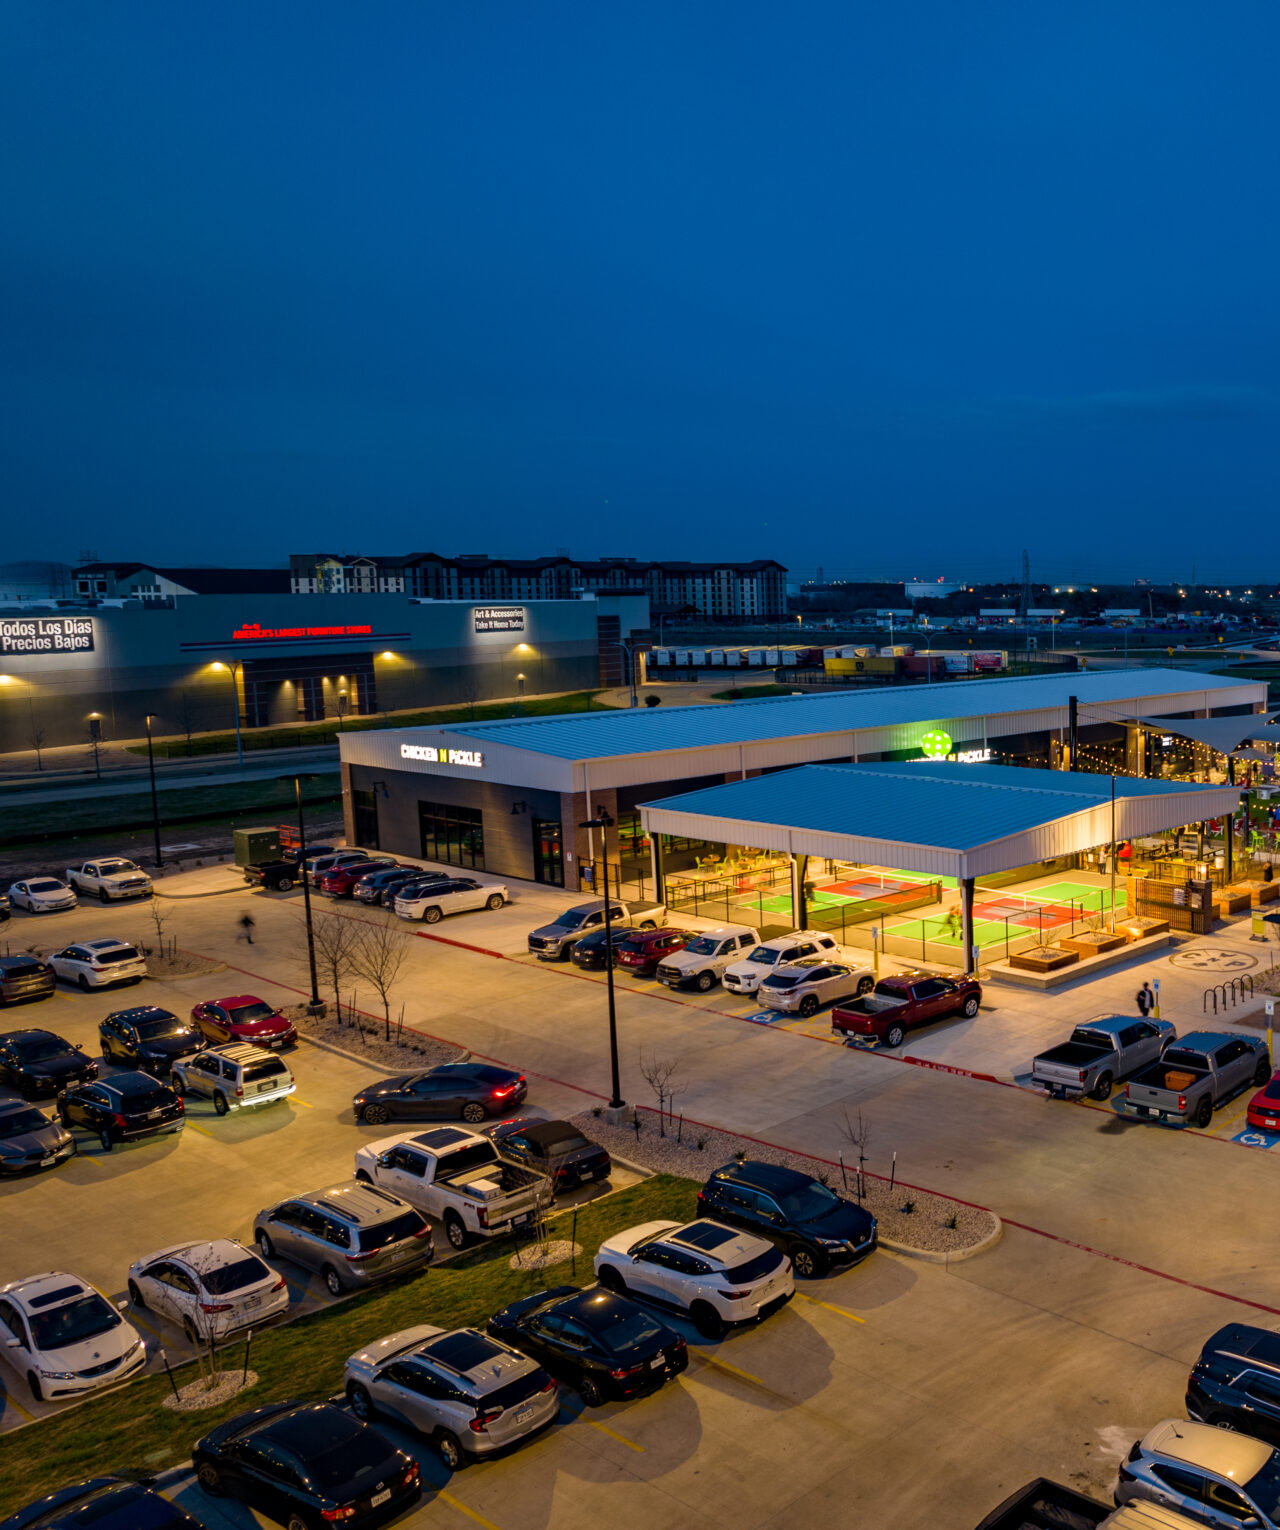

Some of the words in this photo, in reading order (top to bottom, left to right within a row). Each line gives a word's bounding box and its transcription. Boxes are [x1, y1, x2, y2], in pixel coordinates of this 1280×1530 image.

[476, 610, 484, 618] Art
[491, 609, 523, 618] Accessories
[38, 620, 61, 635] Los
[476, 621, 488, 629] Take
[494, 620, 508, 628] Home
[2, 635, 52, 650] Precios
[54, 634, 90, 651] Bajos
[400, 743, 438, 762] CHICKEN
[439, 748, 447, 763] N
